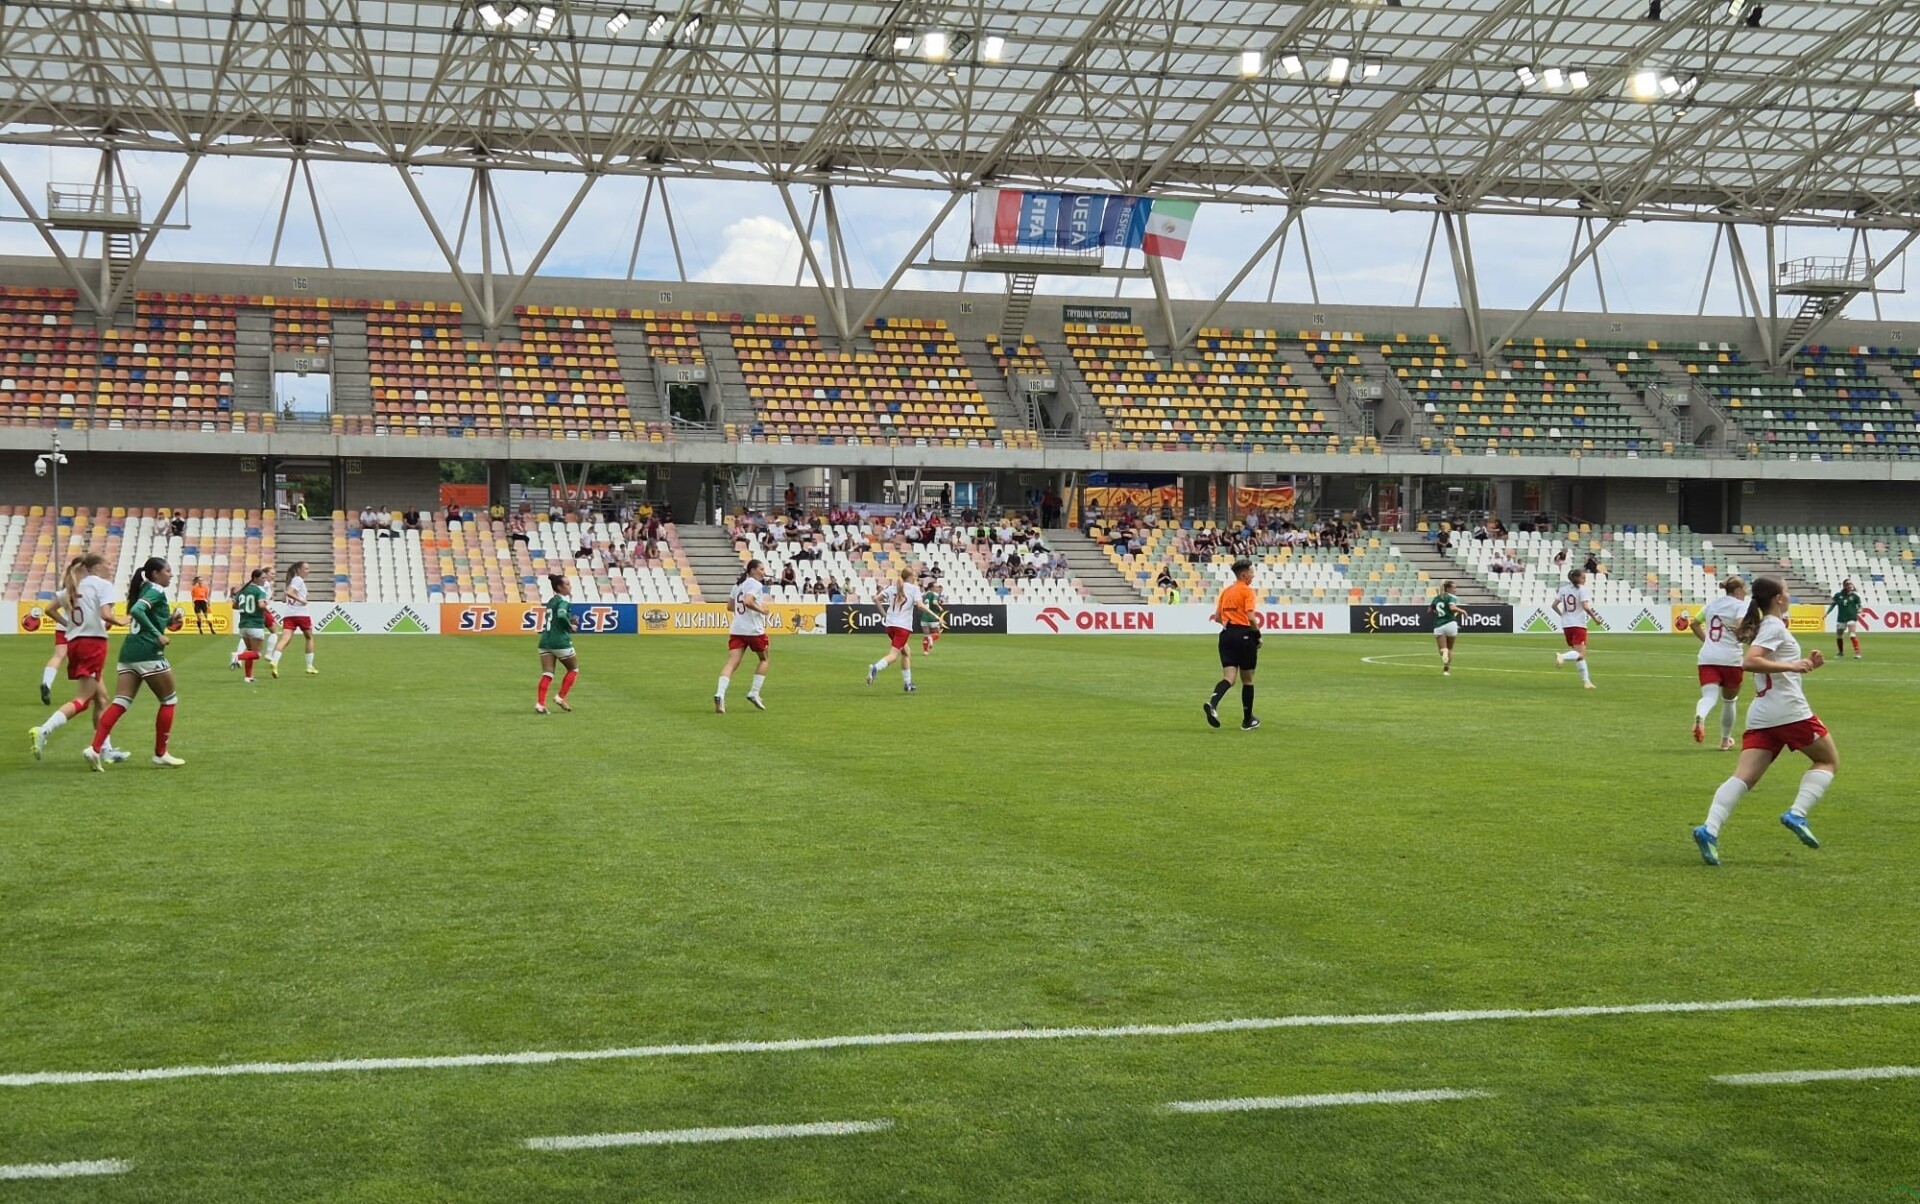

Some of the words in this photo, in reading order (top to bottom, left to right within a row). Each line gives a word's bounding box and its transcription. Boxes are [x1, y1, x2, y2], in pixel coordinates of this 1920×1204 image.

[1029, 197, 1047, 238] FIFA
[1071, 195, 1091, 246] UEFA
[1115, 207, 1132, 246] RESPECT
[239, 594, 255, 614] 20
[1562, 593, 1577, 613] 19
[314, 609, 337, 632] LEROY
[335, 605, 362, 632] MERLIN
[383, 609, 407, 632] LEROY
[404, 605, 431, 632] MERLIN
[459, 605, 497, 632] STS
[581, 607, 619, 633] STS
[674, 612, 731, 629] KUCHNIA
[950, 612, 994, 627] InPost
[1075, 611, 1154, 630] ORLEN
[1379, 612, 1421, 627] InPost
[1461, 613, 1502, 628] InPost
[1709, 615, 1724, 642] 8
